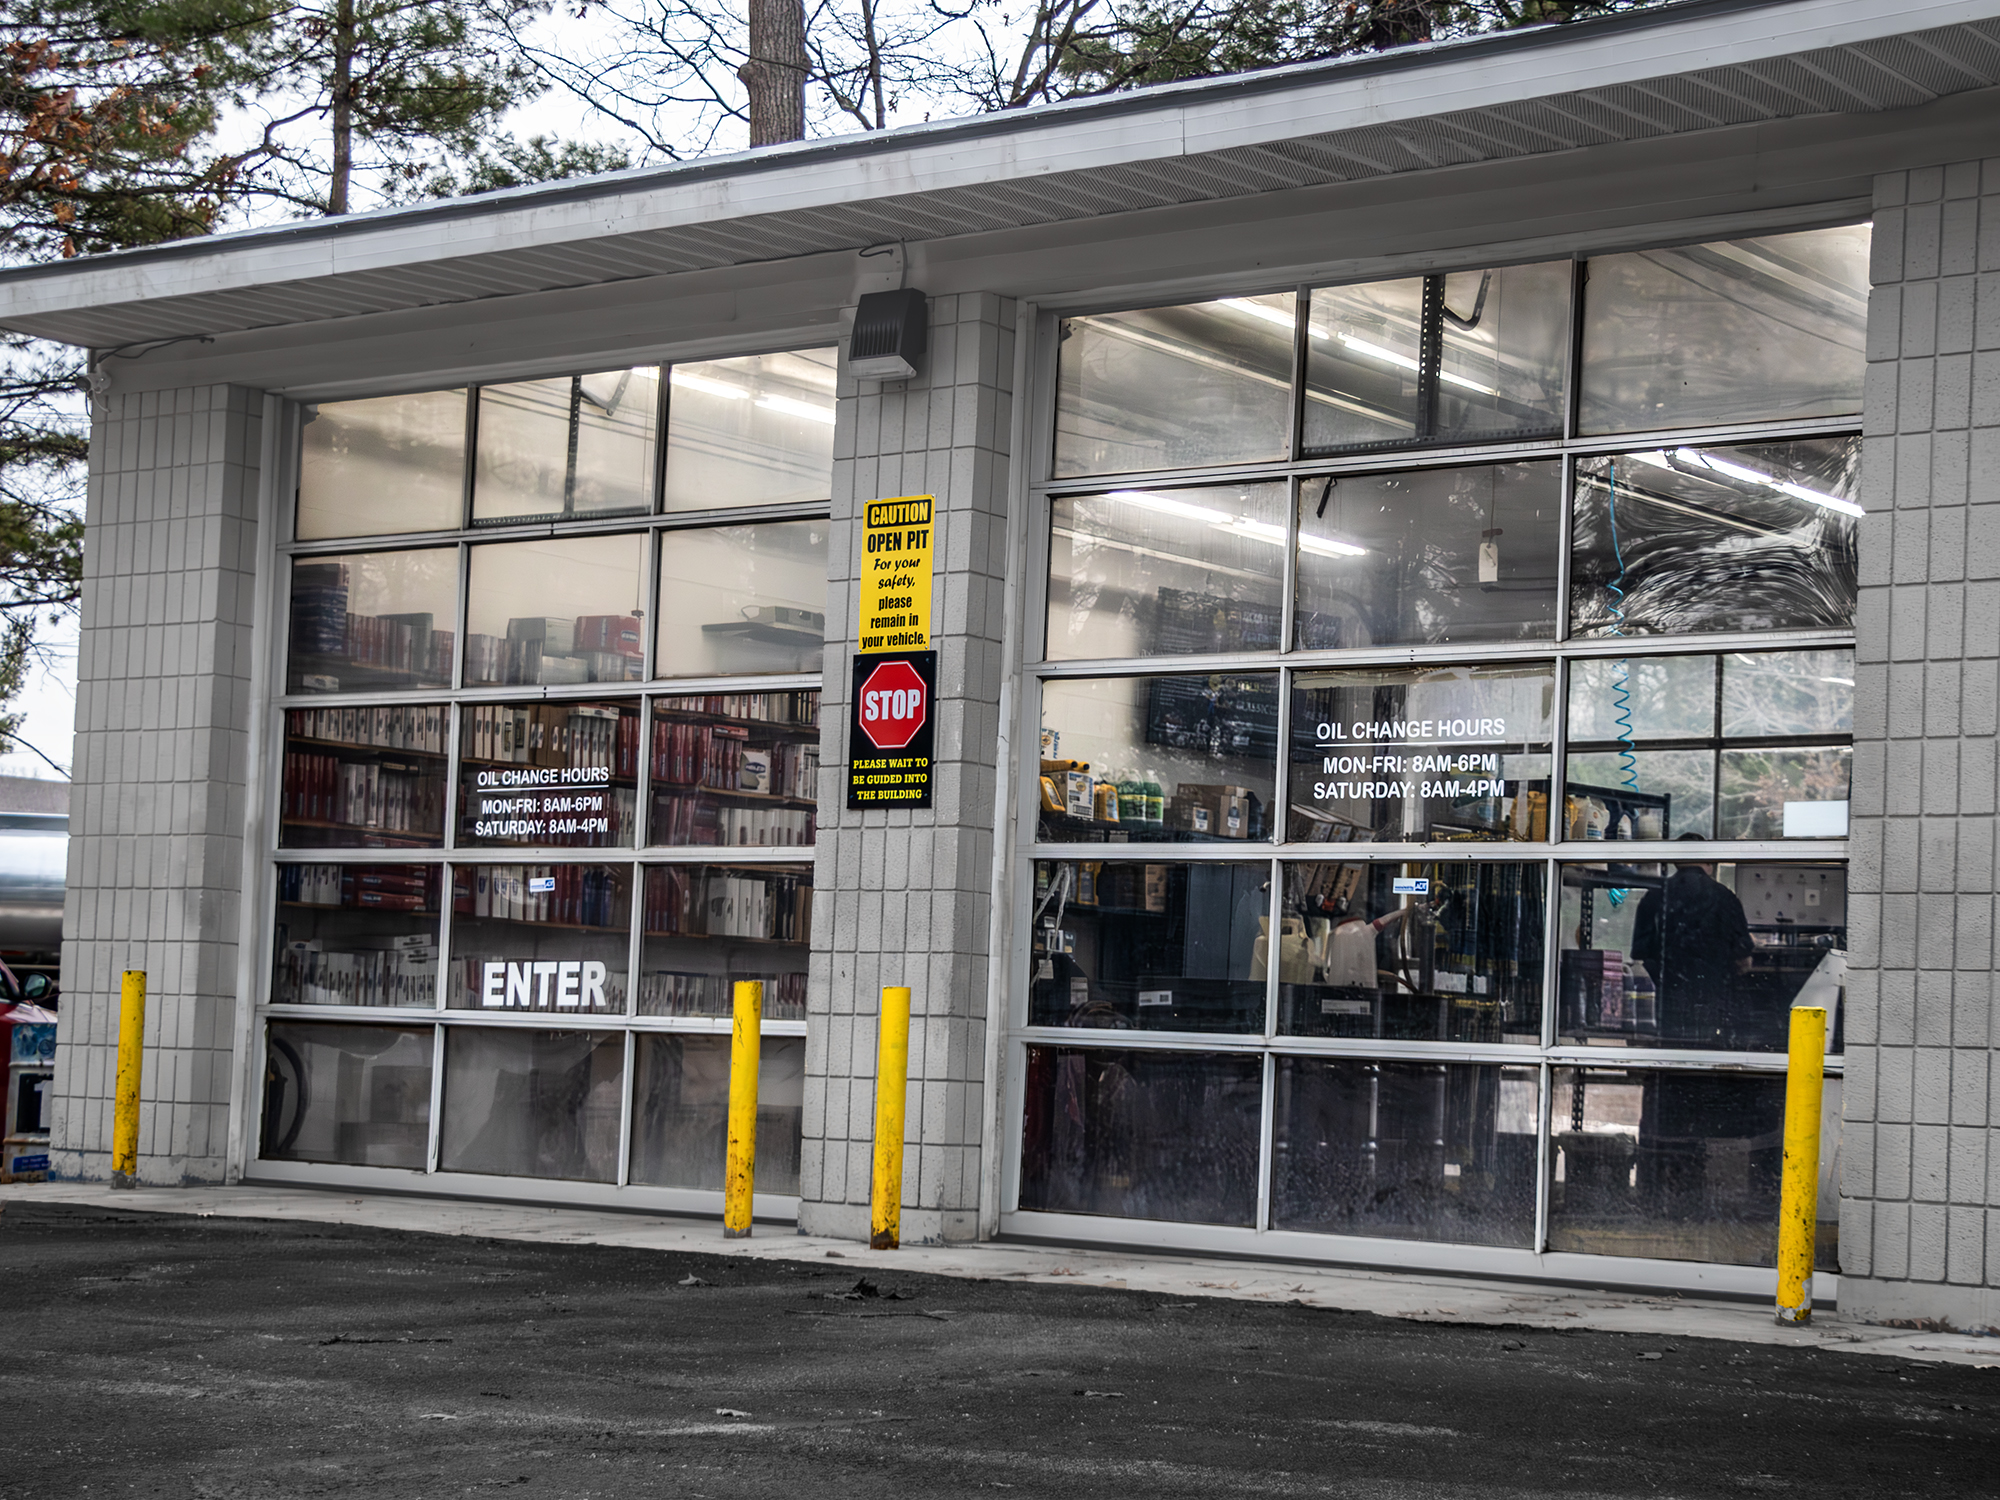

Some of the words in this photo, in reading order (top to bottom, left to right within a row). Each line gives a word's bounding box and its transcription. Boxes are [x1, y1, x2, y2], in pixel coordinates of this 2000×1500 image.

[870, 502, 929, 526] CAUTION
[868, 532, 902, 553] OPEN
[907, 530, 929, 550] PIT
[874, 558, 892, 572] For
[895, 558, 921, 573] your
[878, 574, 916, 591] safety,
[879, 596, 912, 611] please
[871, 614, 905, 629] remain
[908, 613, 919, 628] in
[861, 634, 884, 650] your
[887, 632, 926, 647] vehicle.
[865, 689, 921, 722] STOP
[1316, 722, 1348, 740] OIL
[1352, 720, 1433, 739] CHANGE
[1438, 718, 1506, 737] HOURS
[853, 759, 887, 770] PLEASE
[889, 758, 913, 769] WAIT
[915, 757, 929, 768] TO
[1323, 756, 1408, 774] MON-FRI:
[1410, 754, 1496, 773] 8AM-6PM
[477, 771, 500, 786] OIL
[503, 769, 559, 785] CHANGE
[562, 767, 609, 783] HOURS
[853, 775, 865, 784] BE
[866, 774, 903, 785] GUIDED
[904, 773, 928, 784] INTO
[857, 790, 876, 800] THE
[877, 789, 923, 800] BUILDING
[1314, 781, 1416, 799] SATURDAY:
[1420, 779, 1505, 798] 8AM-4PM
[482, 799, 542, 815] MON-FRI:
[543, 797, 603, 813] 8AM-6PM
[475, 819, 546, 836] SATURDAY:
[549, 818, 608, 834] 8AM-4PM
[482, 961, 606, 1008] ENTER
